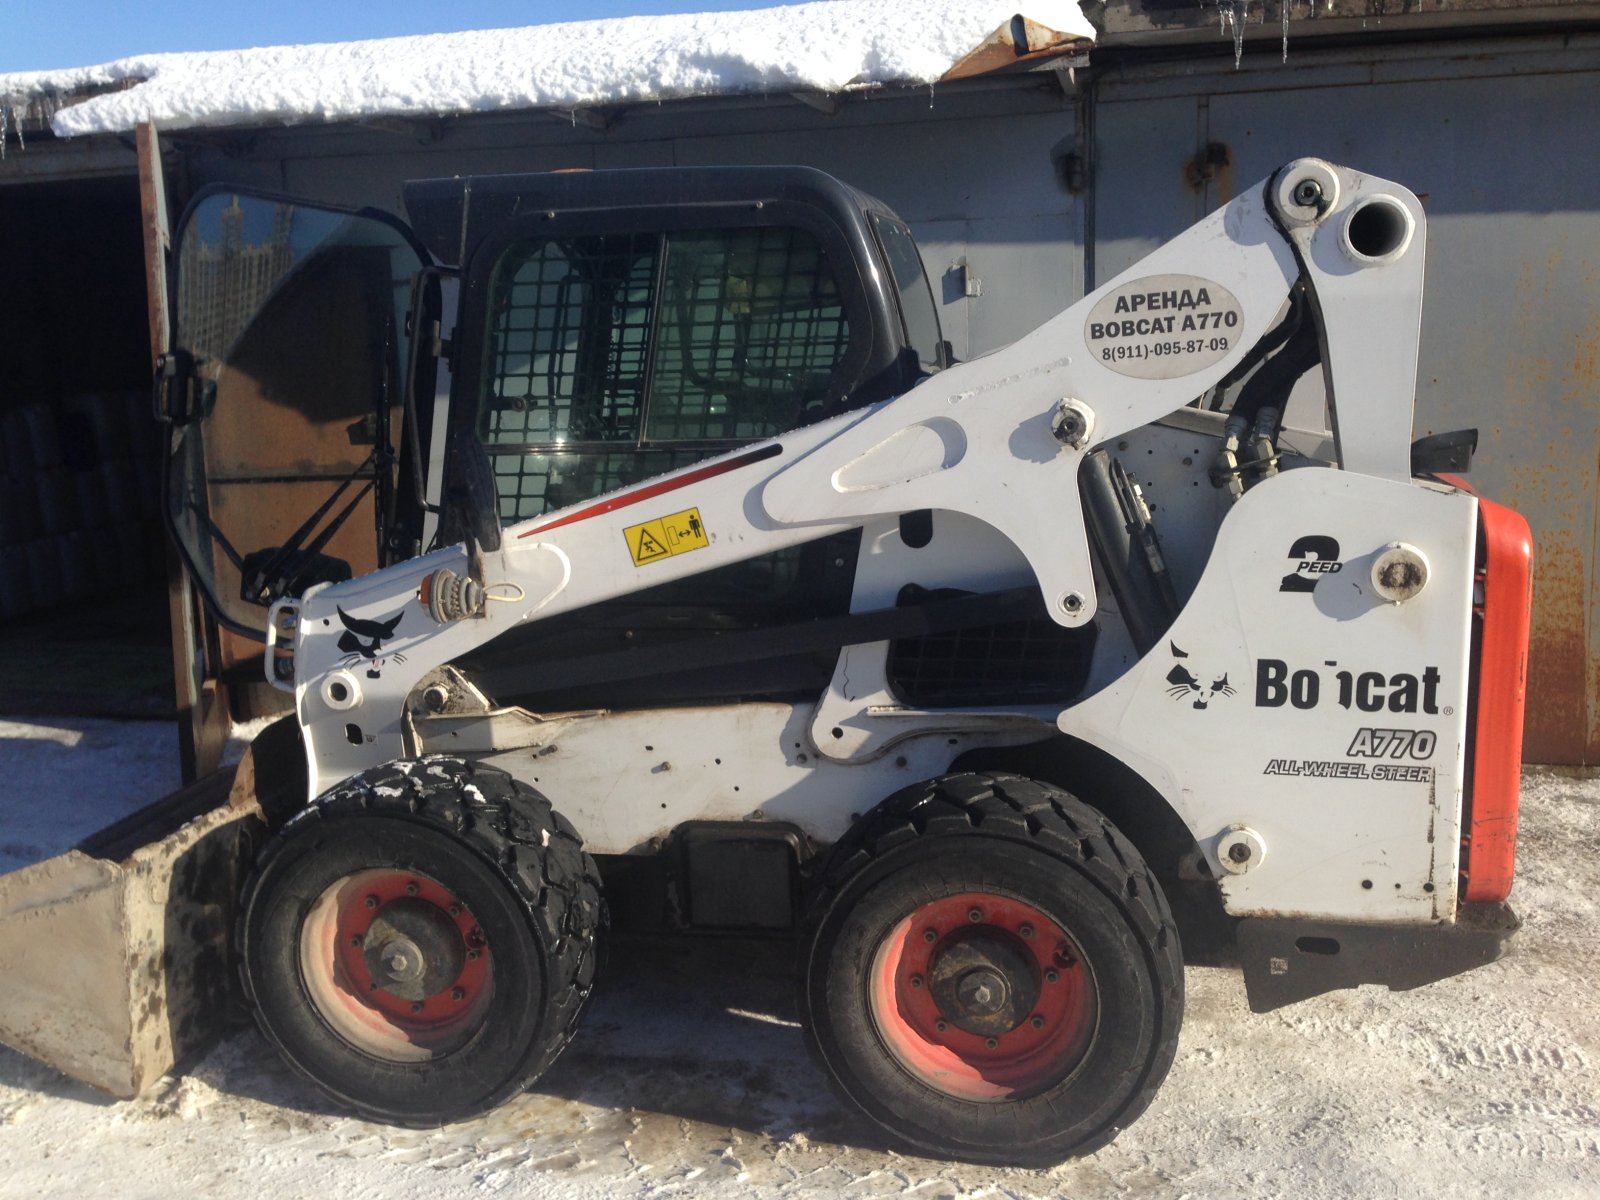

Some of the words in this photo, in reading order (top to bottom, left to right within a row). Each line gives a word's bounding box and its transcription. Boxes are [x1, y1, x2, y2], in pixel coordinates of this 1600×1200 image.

[1114, 287, 1212, 314] АРЕНДА
[1181, 310, 1238, 332] A770
[1102, 337, 1229, 363] 8(911)-095-87-09
[1346, 727, 1438, 760] A770
[1371, 764, 1433, 783] STEER
